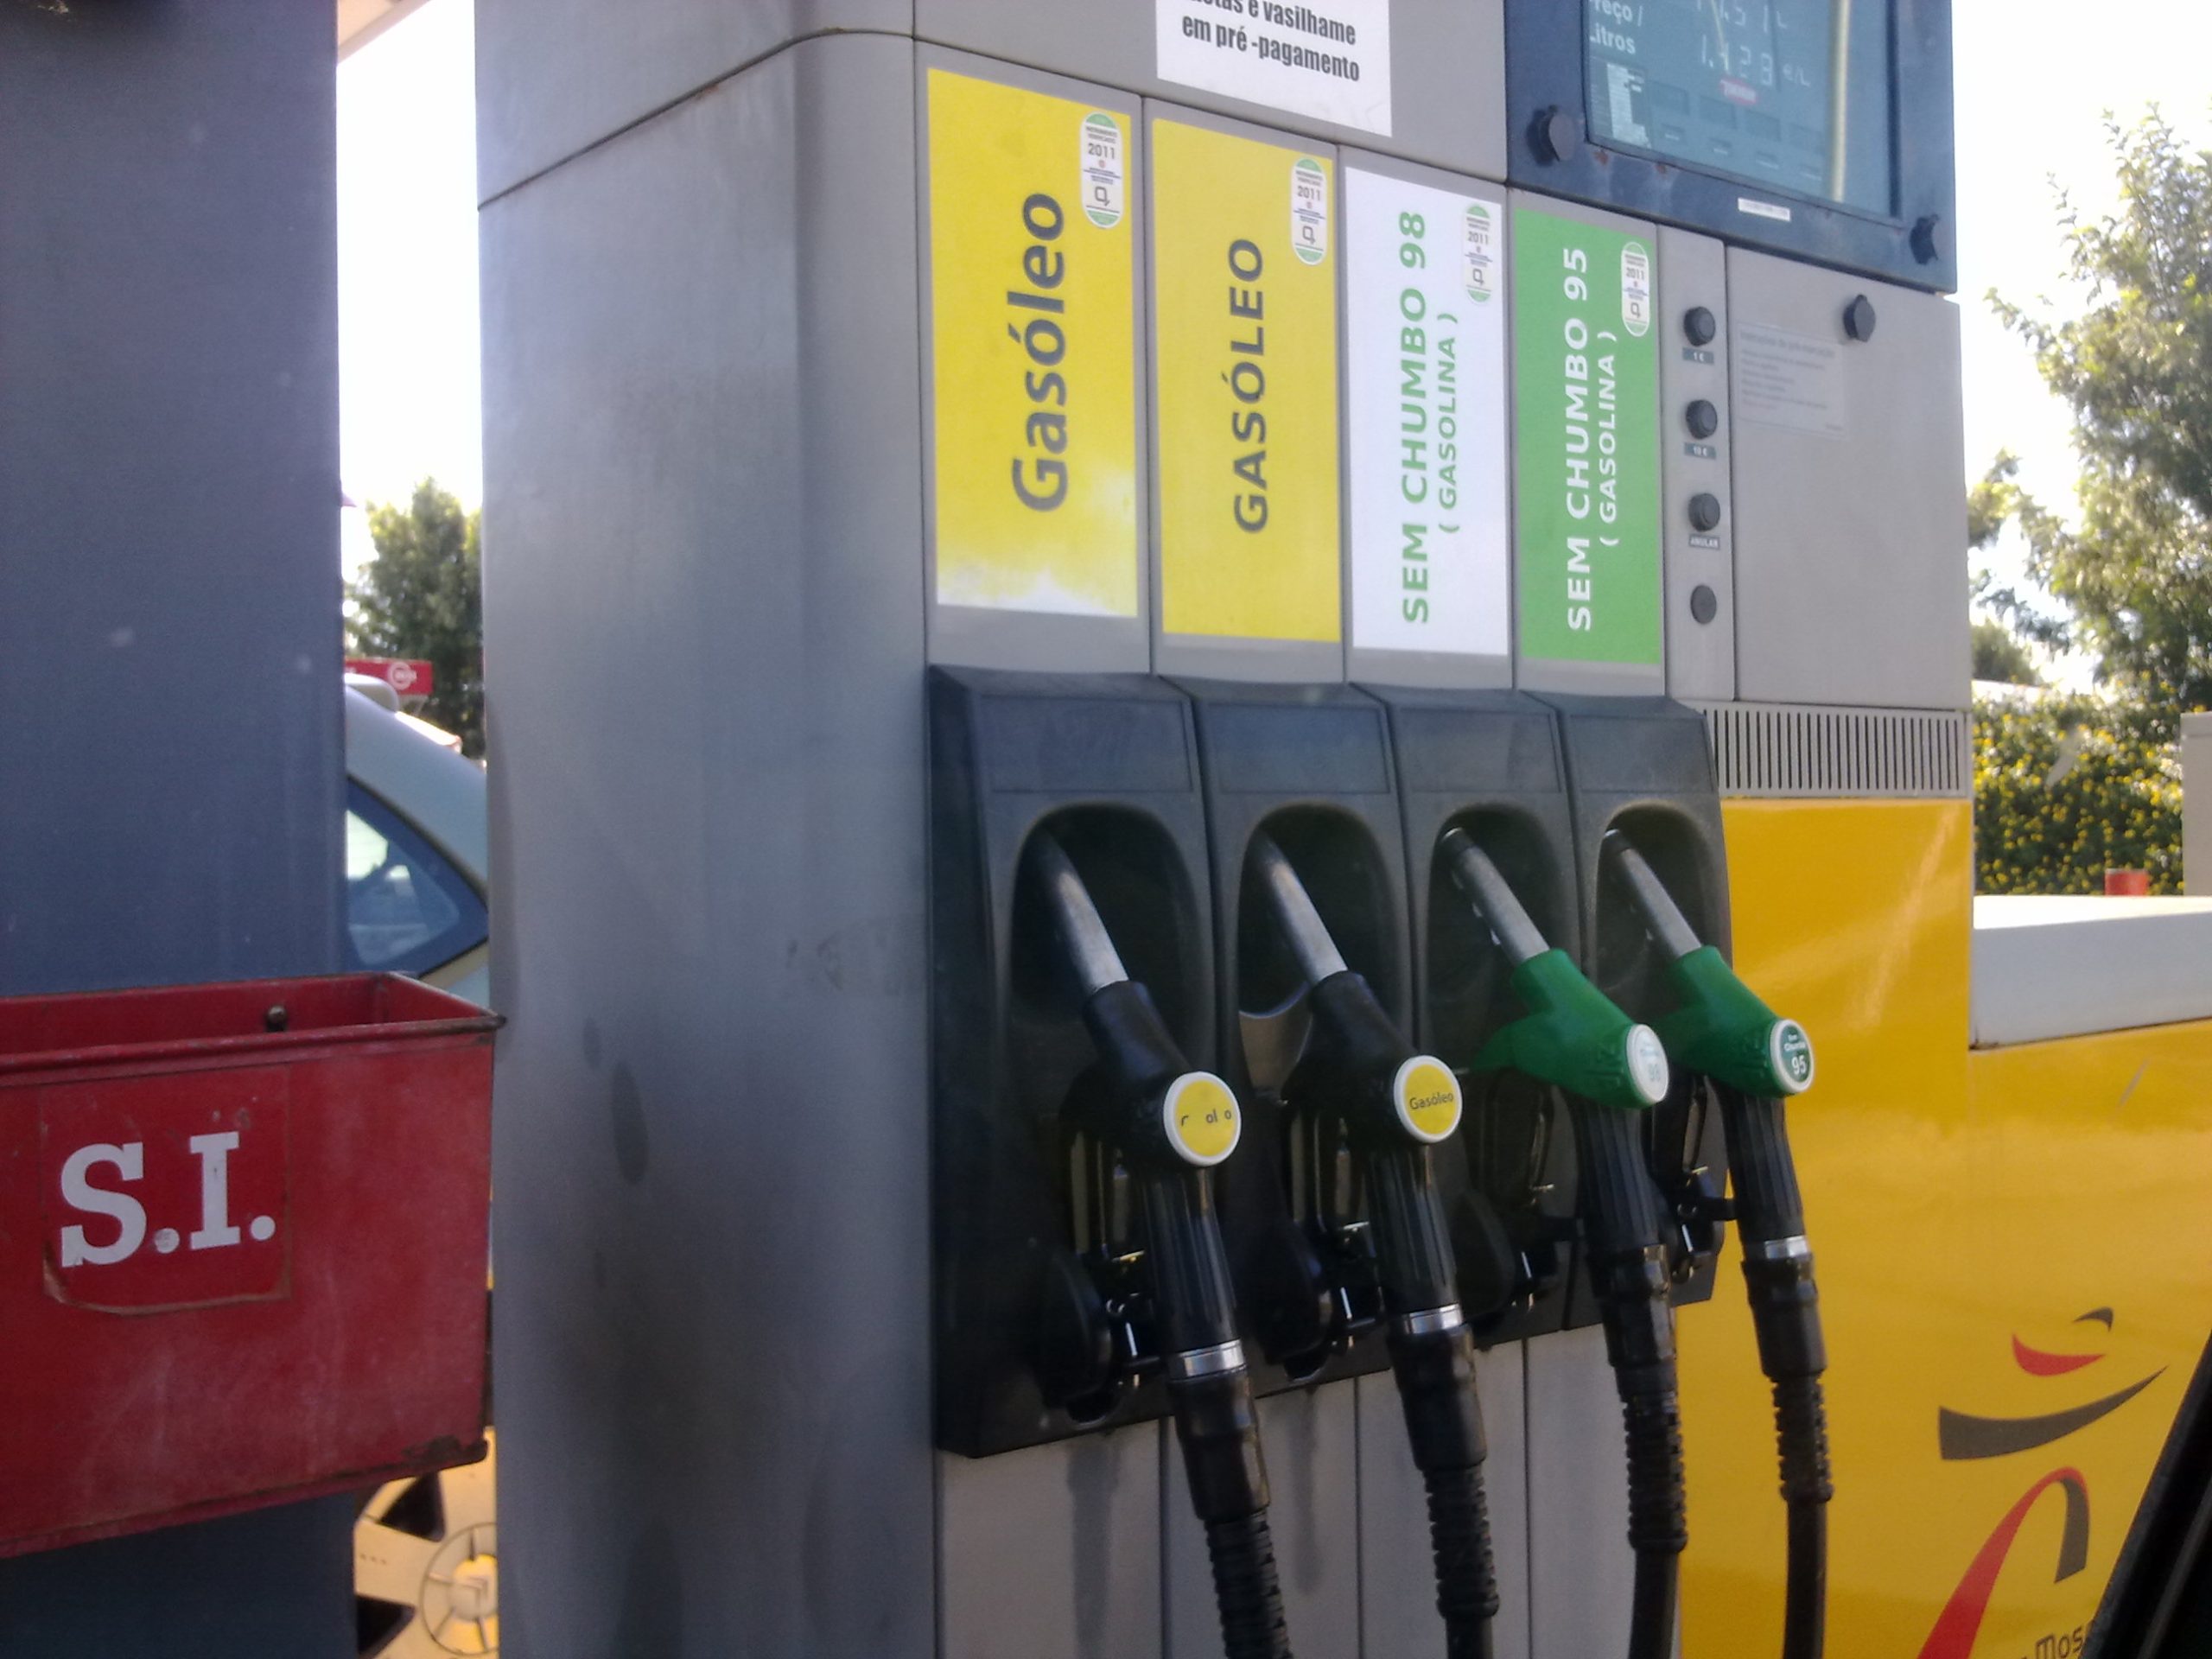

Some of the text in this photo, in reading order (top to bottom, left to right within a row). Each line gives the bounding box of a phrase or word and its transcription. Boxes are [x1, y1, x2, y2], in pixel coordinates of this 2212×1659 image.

[1263, 1, 1356, 45] vasilhame
[1590, 0, 1633, 24] reço
[1183, 16, 1211, 42] em
[1216, 25, 1247, 52] pré
[1087, 142, 1116, 160] 2011
[1296, 184, 1321, 201] 2011
[1467, 230, 1489, 245] 2011
[1625, 266, 1645, 281] 2011
[1007, 193, 1068, 512] Gasóleo
[1221, 238, 1268, 533] GASÓLEO
[1398, 211, 1429, 624] SEM CHUMBO 98
[1563, 248, 1592, 631] SEM CHUMBO 95
[1791, 1055, 1807, 1076] 95
[1409, 1091, 1454, 1110] Gasóleo
[60, 1131, 276, 1268] S.I.
